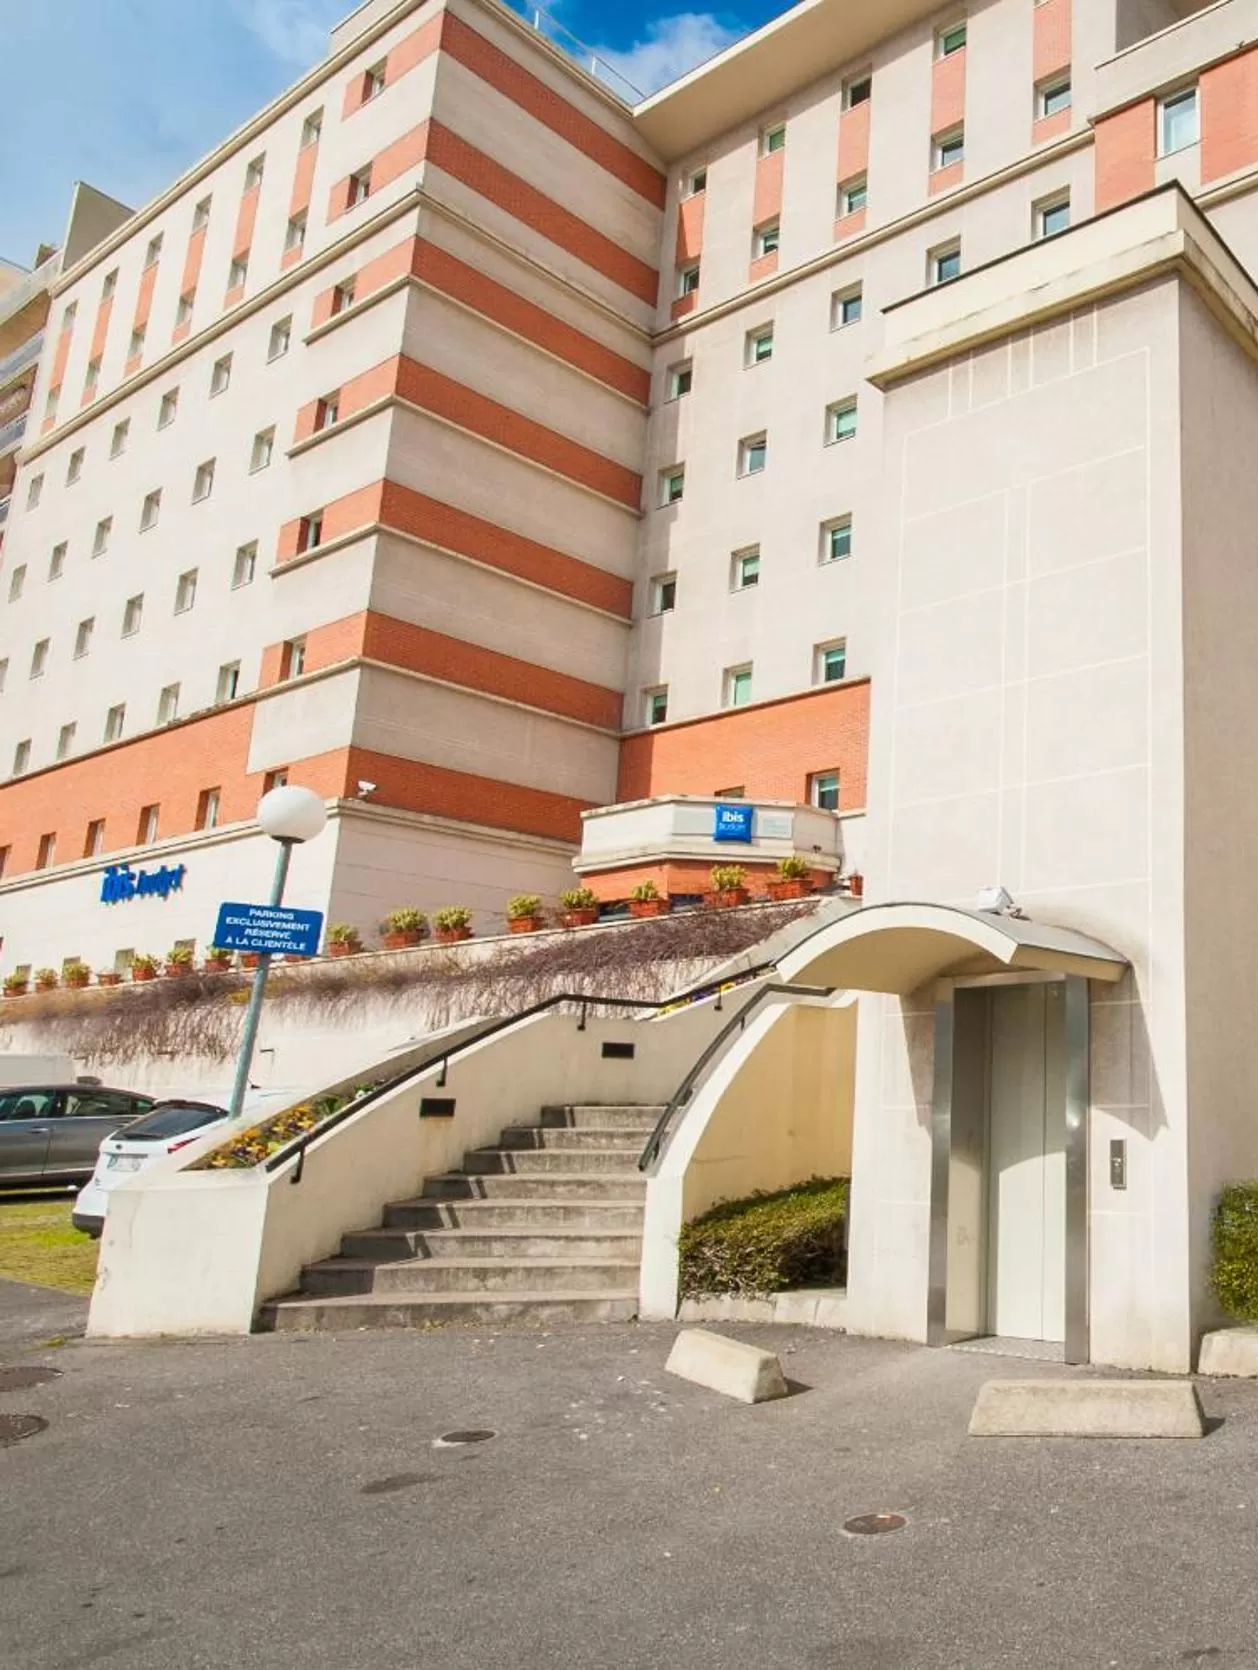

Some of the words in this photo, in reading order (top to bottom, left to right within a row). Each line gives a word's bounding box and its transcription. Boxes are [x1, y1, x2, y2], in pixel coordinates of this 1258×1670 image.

[721, 811, 745, 823] ibis
[100, 863, 137, 905] ibis
[249, 908, 295, 920] PARKING
[225, 916, 311, 932] EXCLUSIVEMENT
[235, 938, 249, 946] LA
